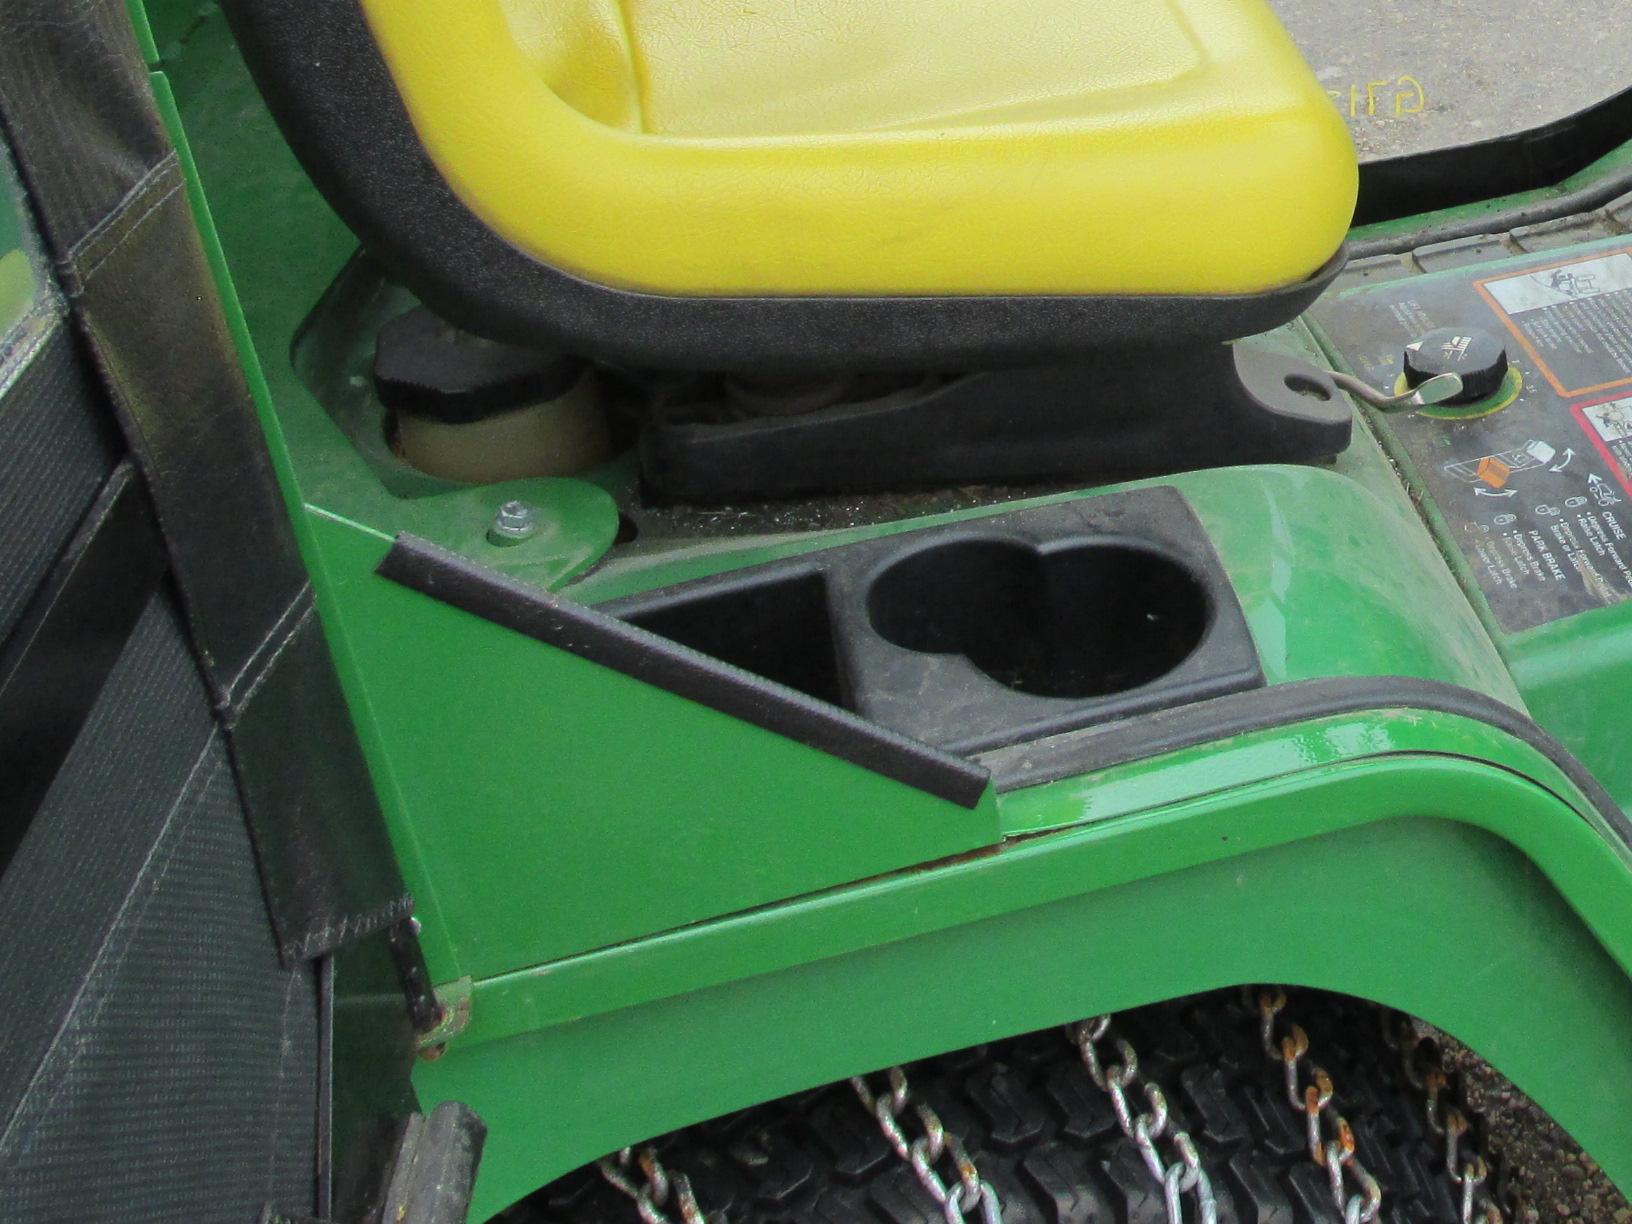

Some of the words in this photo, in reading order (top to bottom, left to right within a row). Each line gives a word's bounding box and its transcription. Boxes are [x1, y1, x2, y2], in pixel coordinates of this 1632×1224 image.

[1550, 525, 1566, 542] Brake
[1577, 518, 1594, 535] Raise
[1589, 537, 1606, 555] Latch
[1603, 511, 1626, 540] CRUISE
[1513, 534, 1534, 559] Depress
[1528, 530, 1547, 551] PARK
[1542, 553, 1564, 580] BRAKE
[1587, 516, 1609, 541] Depress
[1604, 543, 1627, 569] Forward
[1487, 565, 1503, 583] Latch
[1501, 569, 1517, 587] Brake
[1514, 557, 1530, 574] Latch
